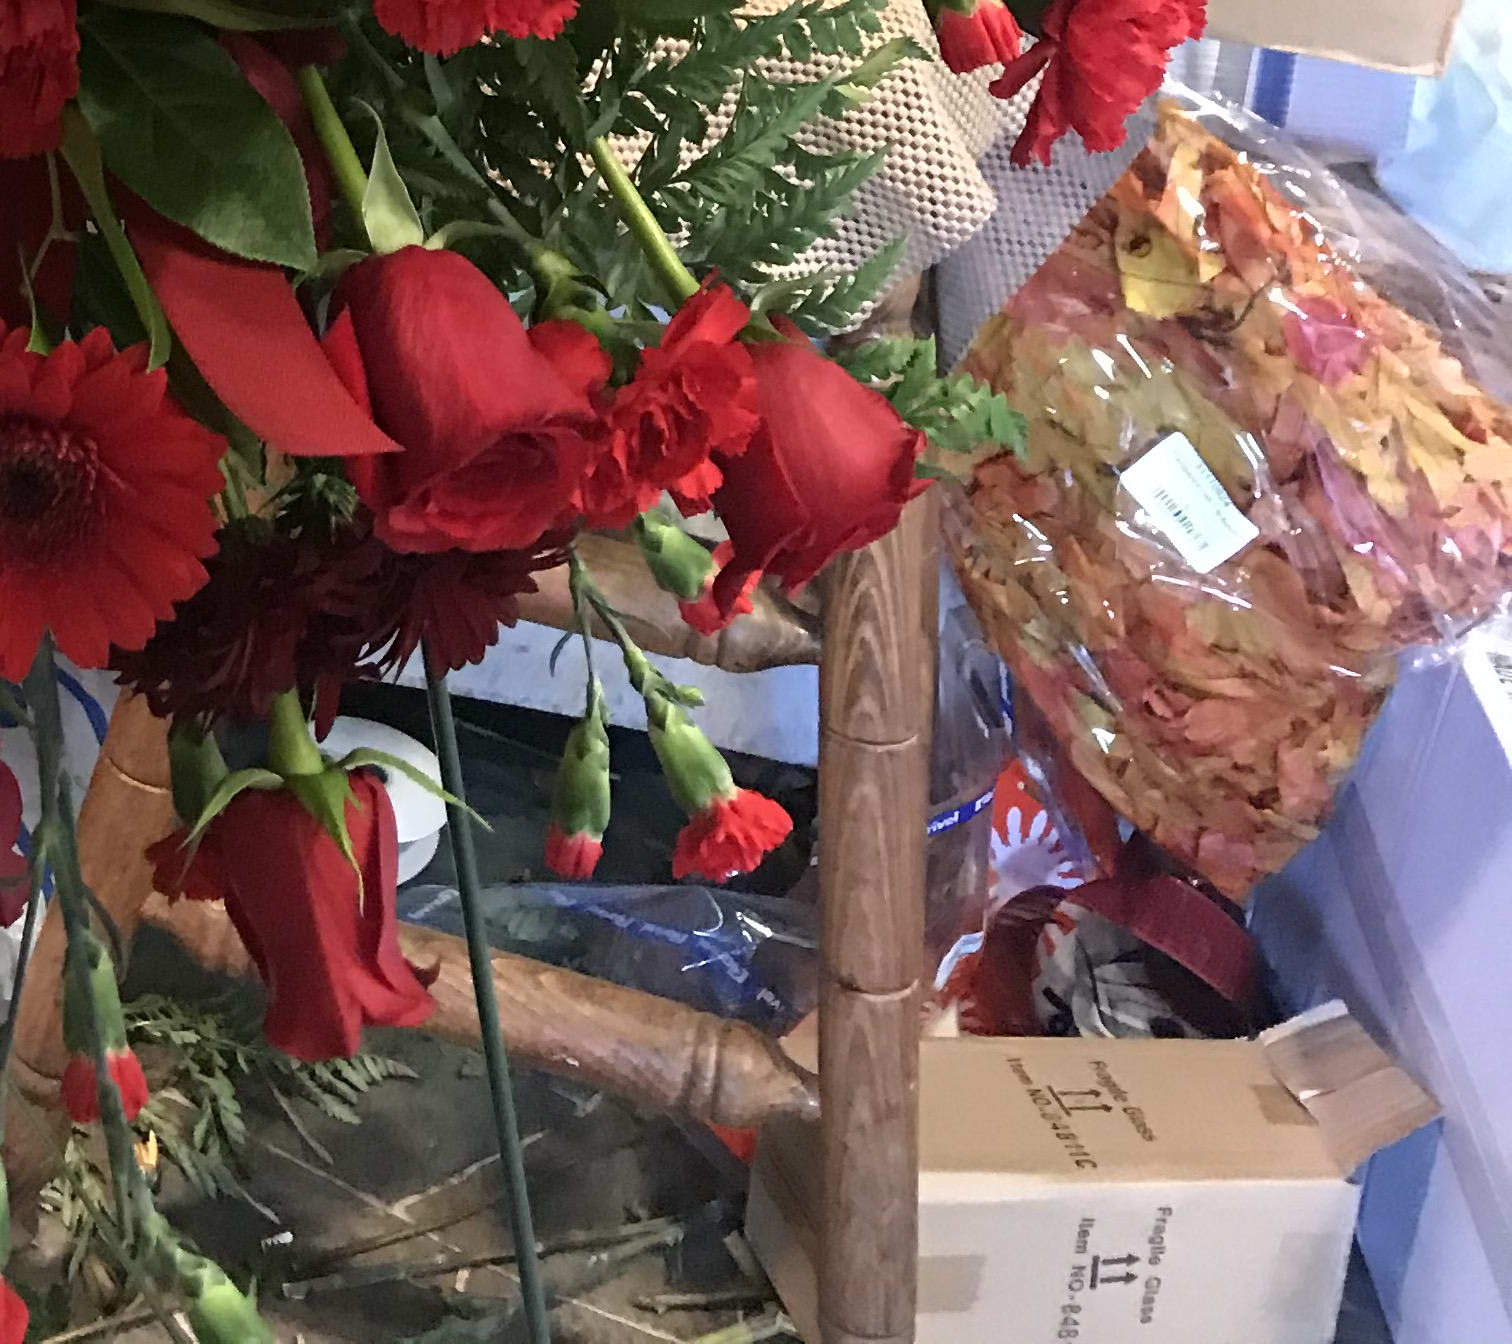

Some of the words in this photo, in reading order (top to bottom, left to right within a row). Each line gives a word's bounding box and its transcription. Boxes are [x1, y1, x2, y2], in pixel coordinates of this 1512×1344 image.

[1073, 1217, 1096, 1254] Item
[1147, 1206, 1173, 1266] Fragile
[1057, 1265, 1087, 1344] NO.848
[1139, 1276, 1162, 1324] Glass
